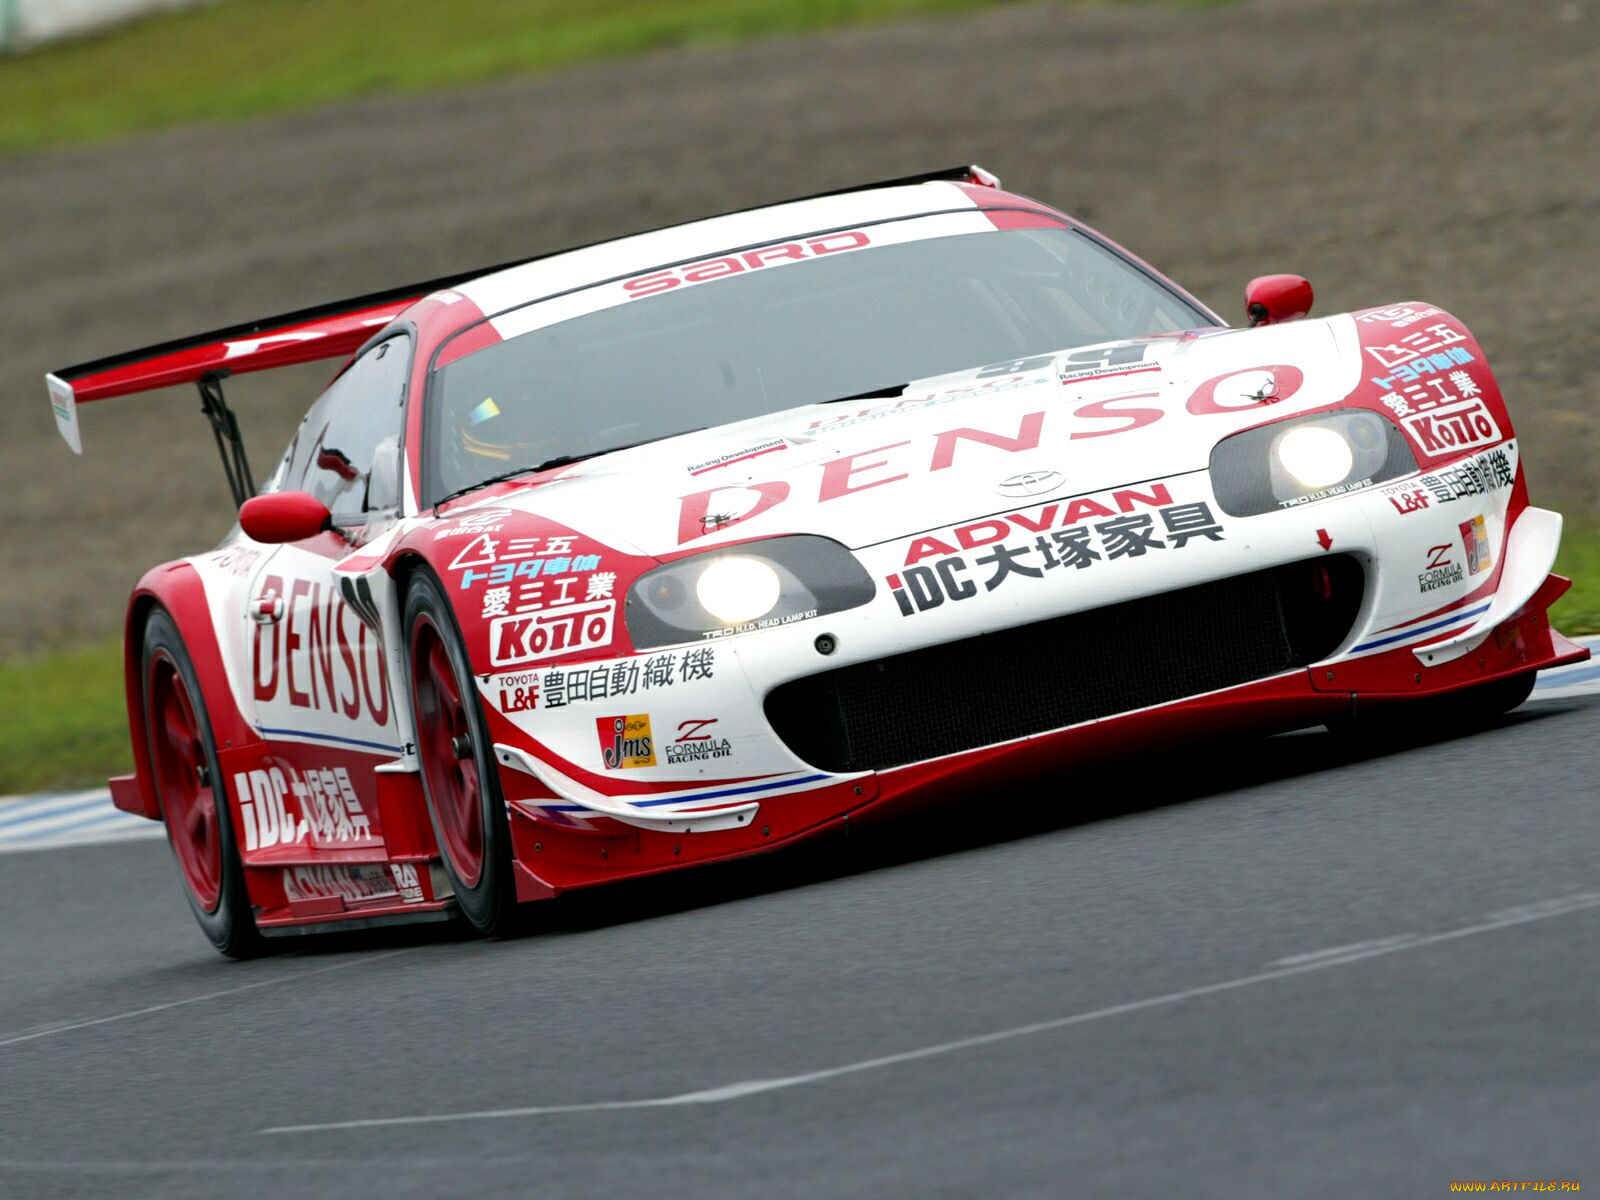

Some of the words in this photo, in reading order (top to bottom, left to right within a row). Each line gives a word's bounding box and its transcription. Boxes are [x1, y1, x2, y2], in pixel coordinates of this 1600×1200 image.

[1059, 371, 1094, 380] Racing
[1095, 361, 1160, 374] Development
[677, 365, 1304, 545] DENSO
[687, 458, 721, 472] Racing
[721, 438, 785, 462] Development
[1380, 481, 1419, 497] TOYOTA
[1388, 489, 1431, 515] L&F
[904, 483, 1174, 567] ADVAN
[1418, 562, 1463, 585] FORMULA
[1420, 576, 1452, 593] RACING
[1452, 571, 1464, 584] OIL
[702, 628, 734, 639] TRD
[735, 623, 757, 633] H.I.D.
[758, 618, 780, 629] HEAD
[781, 611, 804, 624] LAMP
[804, 609, 818, 619] KIT
[253, 574, 389, 727] DENSO
[499, 672, 539, 687] TOYOTA
[499, 684, 540, 713] L&F
[665, 737, 732, 757] FORMULA
[667, 752, 710, 765] RACING
[712, 748, 732, 759] OIL
